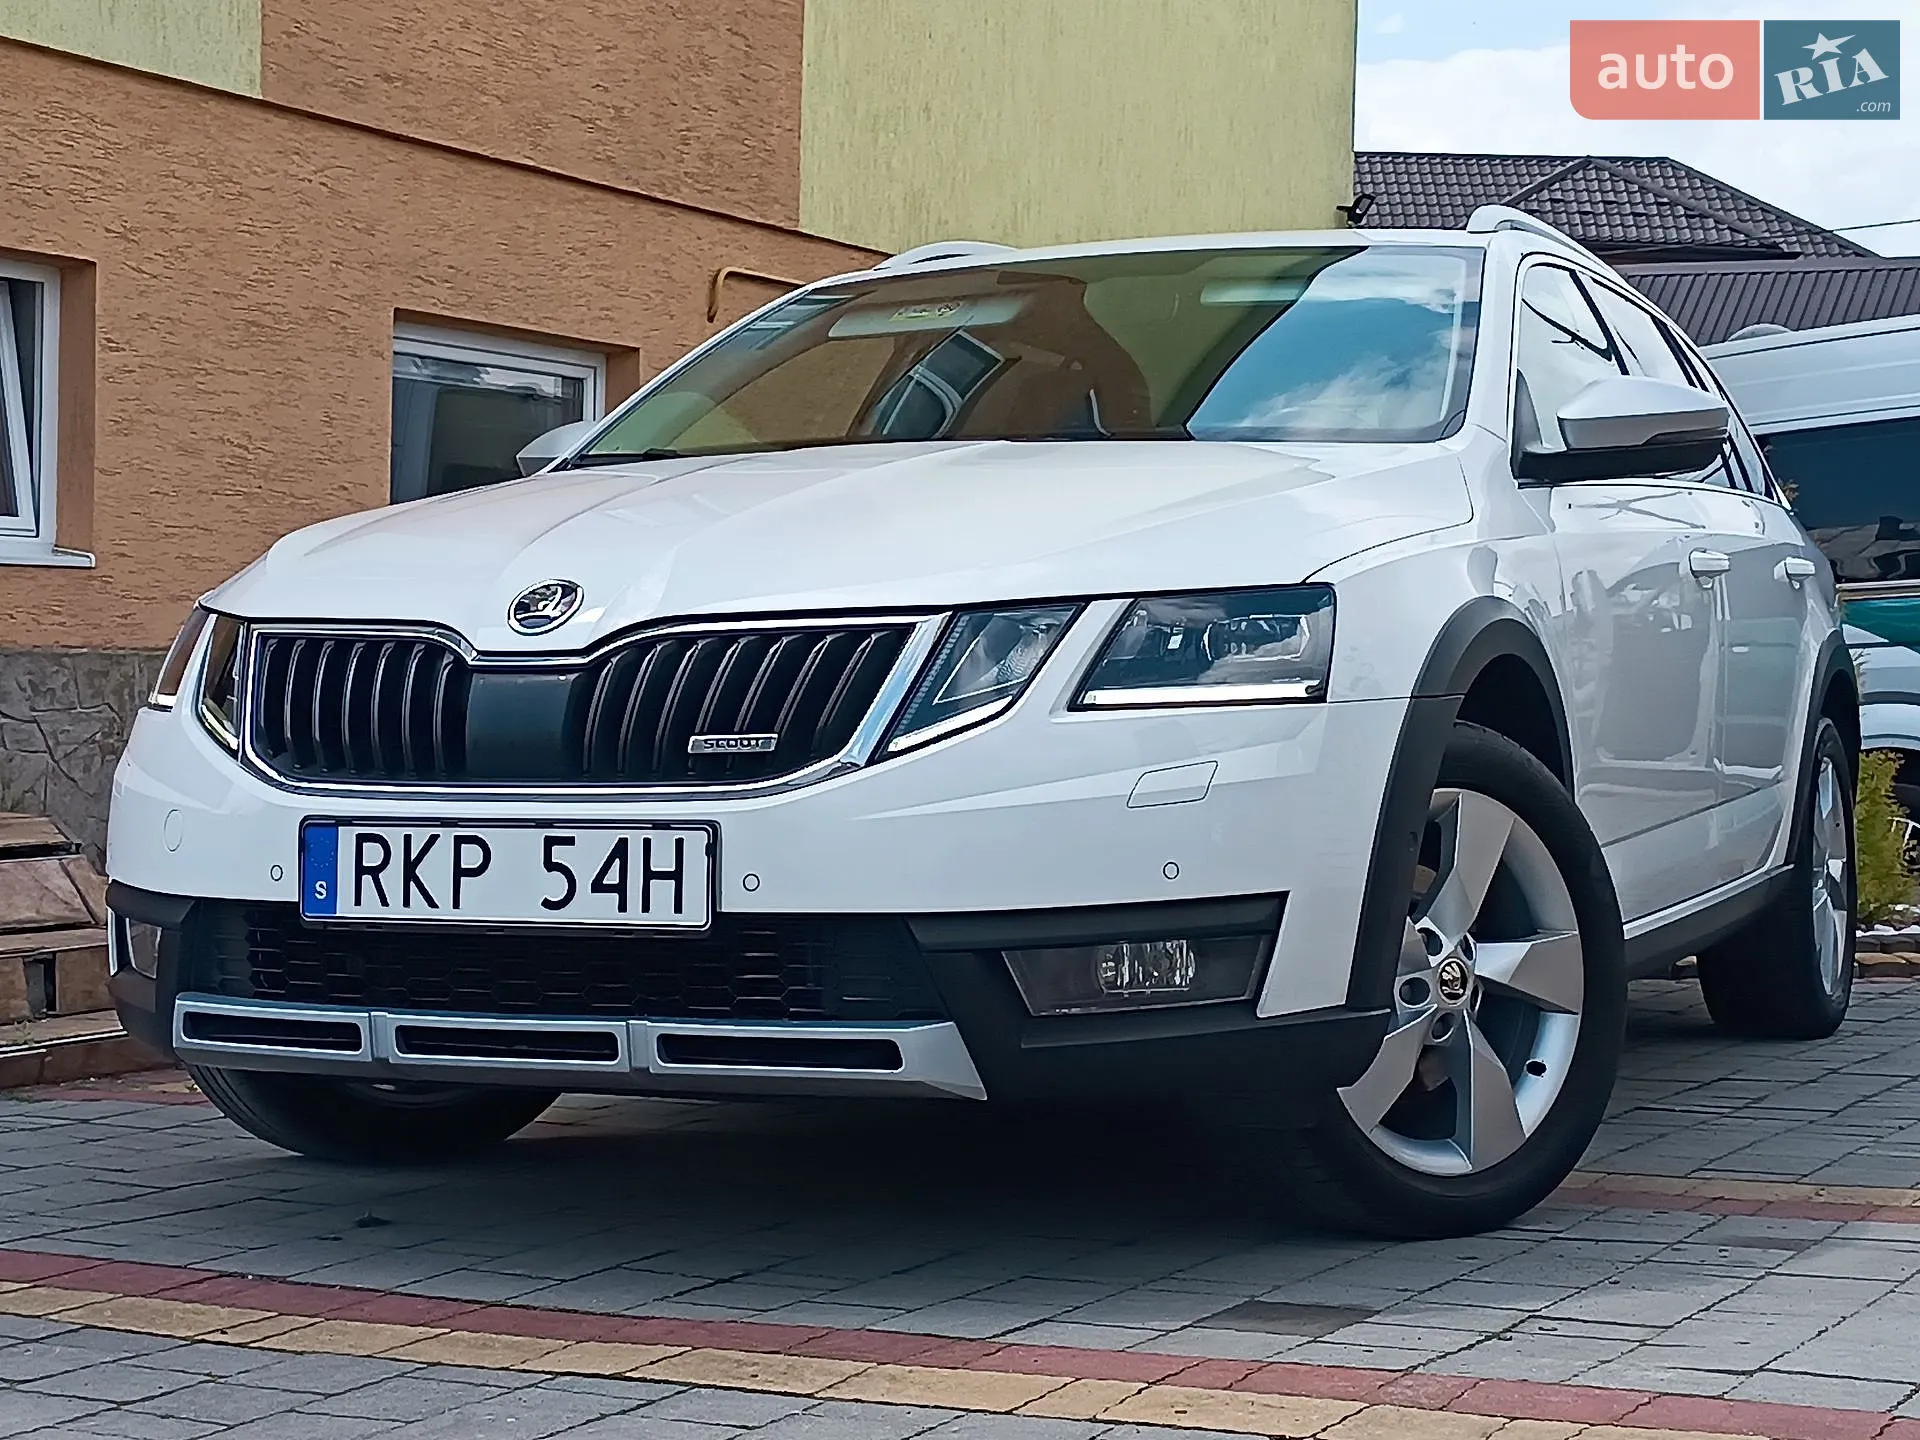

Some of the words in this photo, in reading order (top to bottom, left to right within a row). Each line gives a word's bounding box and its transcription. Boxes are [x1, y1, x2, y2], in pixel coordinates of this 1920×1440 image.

[315, 881, 328, 899] S
[353, 832, 492, 910] RKP
[540, 835, 686, 915] 54H
